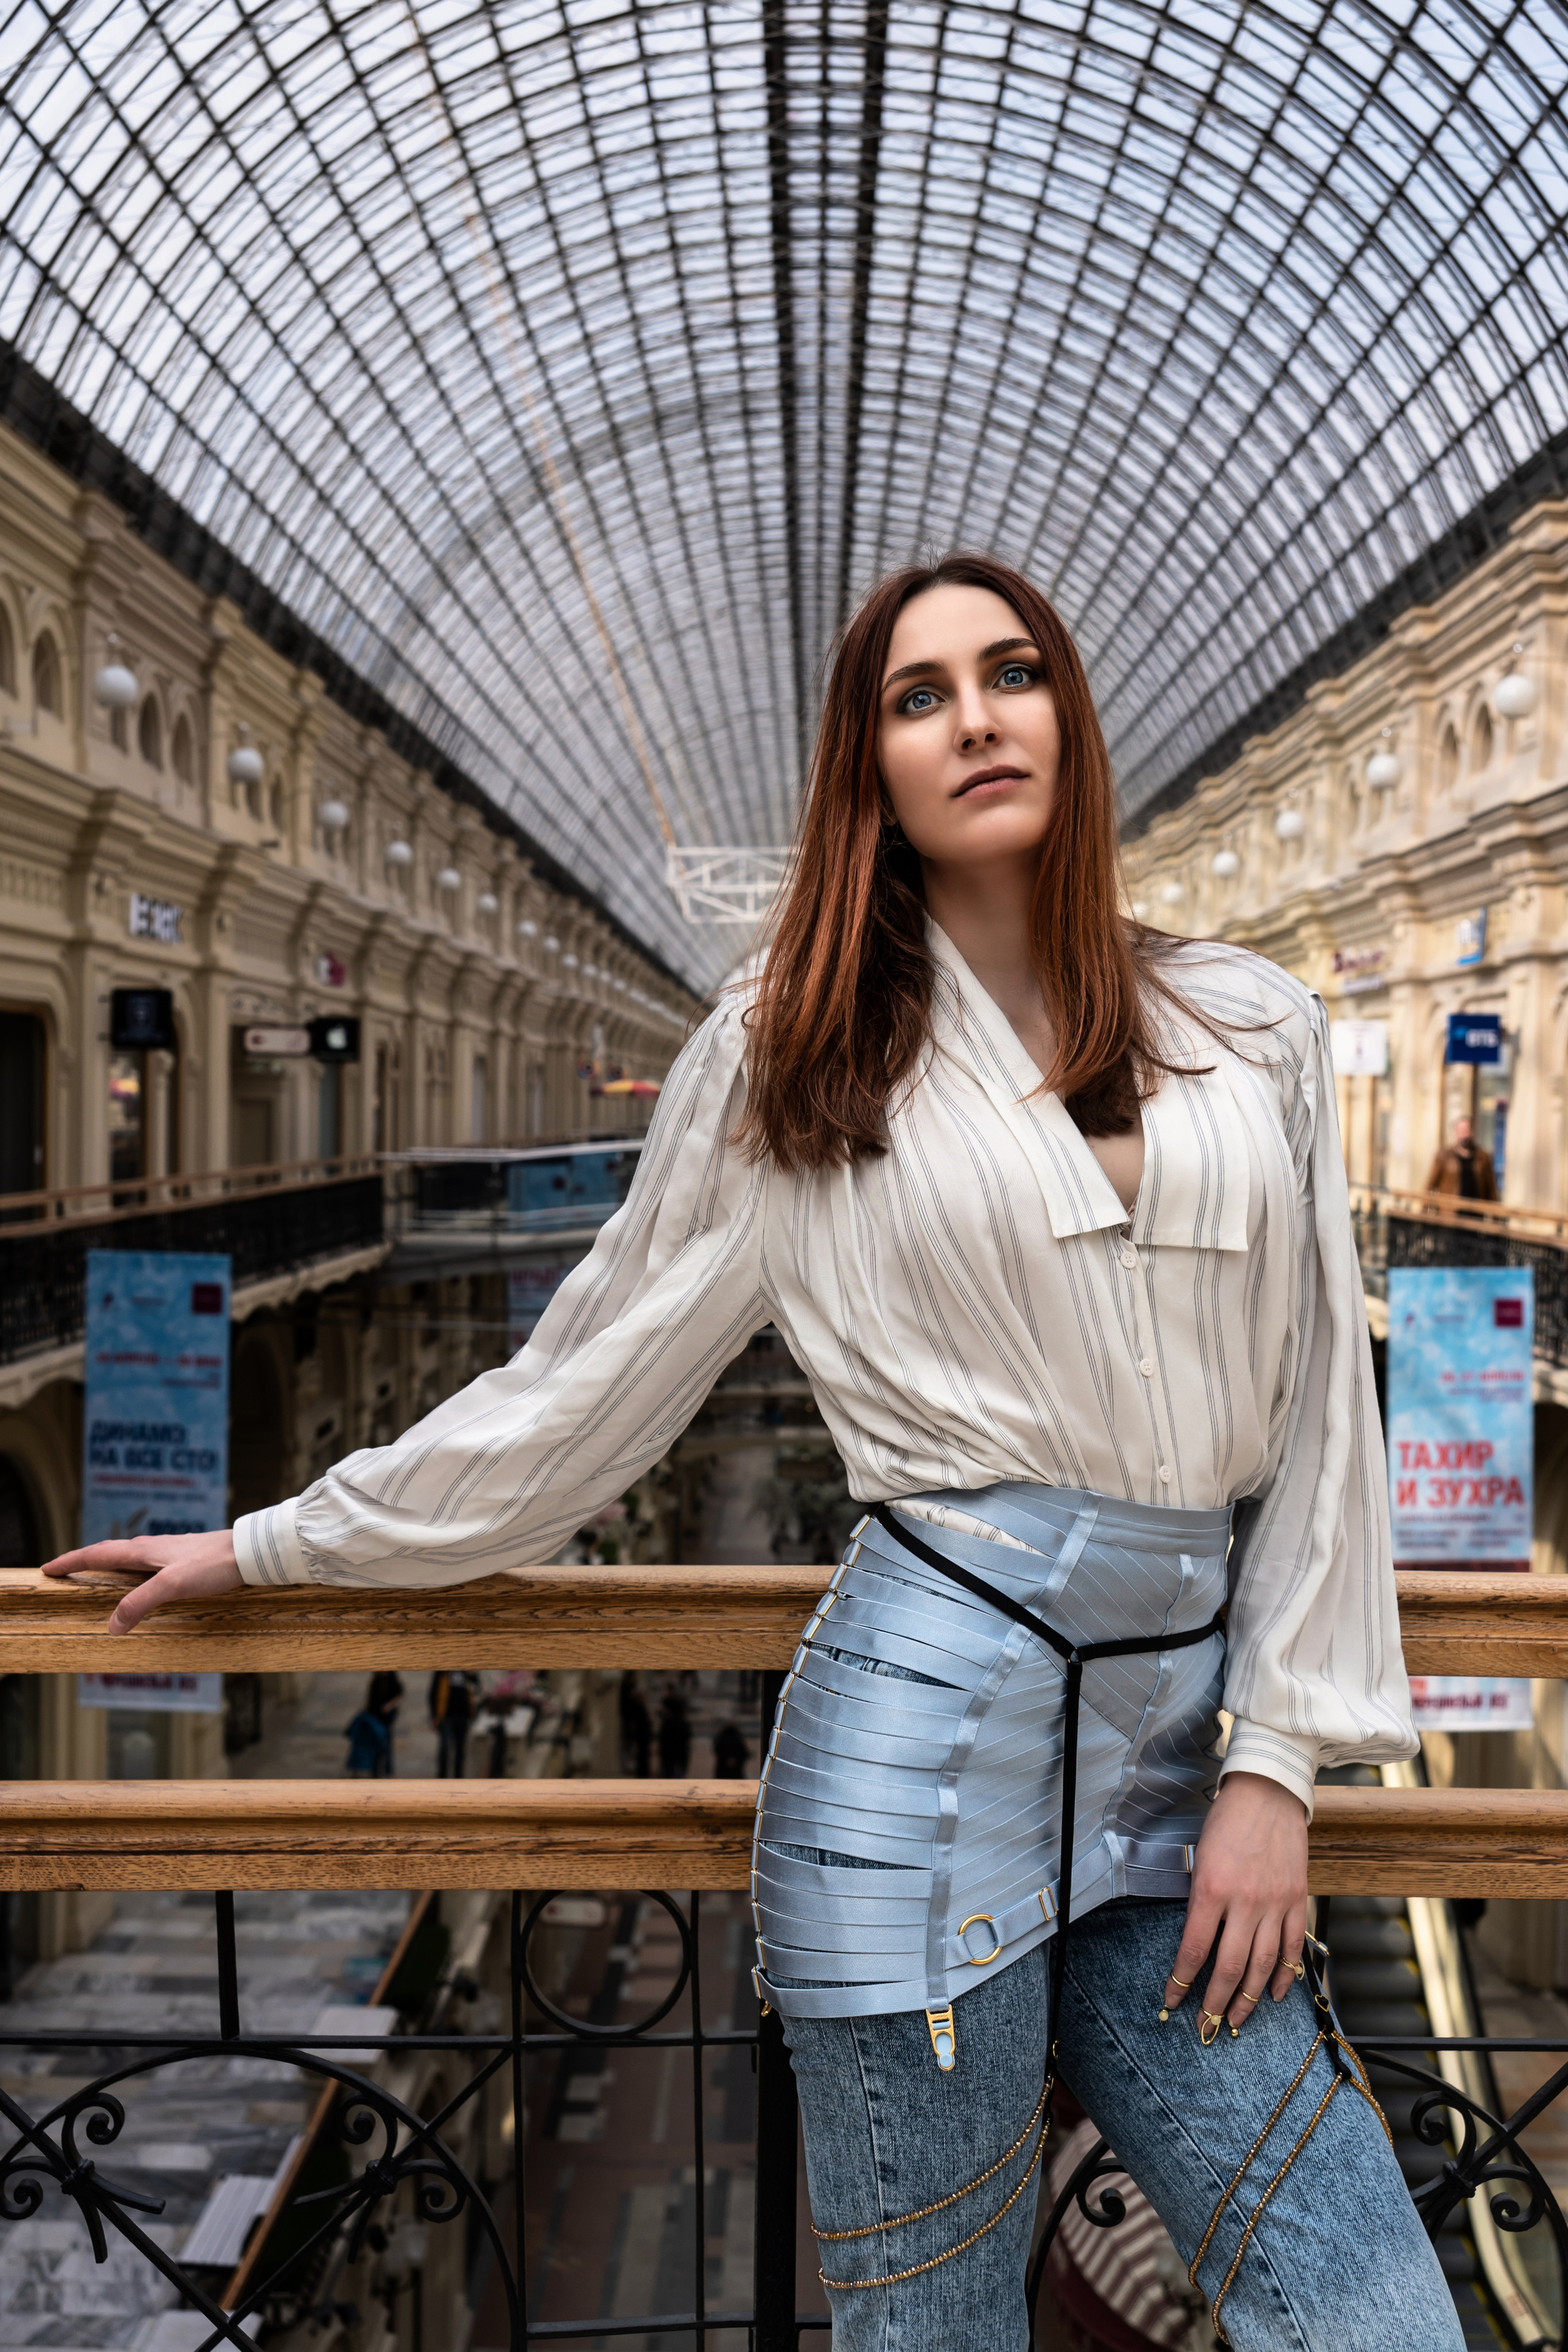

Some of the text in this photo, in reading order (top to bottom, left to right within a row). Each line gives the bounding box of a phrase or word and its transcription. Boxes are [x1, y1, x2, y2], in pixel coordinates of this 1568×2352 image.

[1397, 1441, 1493, 1470] ТАХИР
[1397, 1476, 1525, 1507] И ЗУХРА
